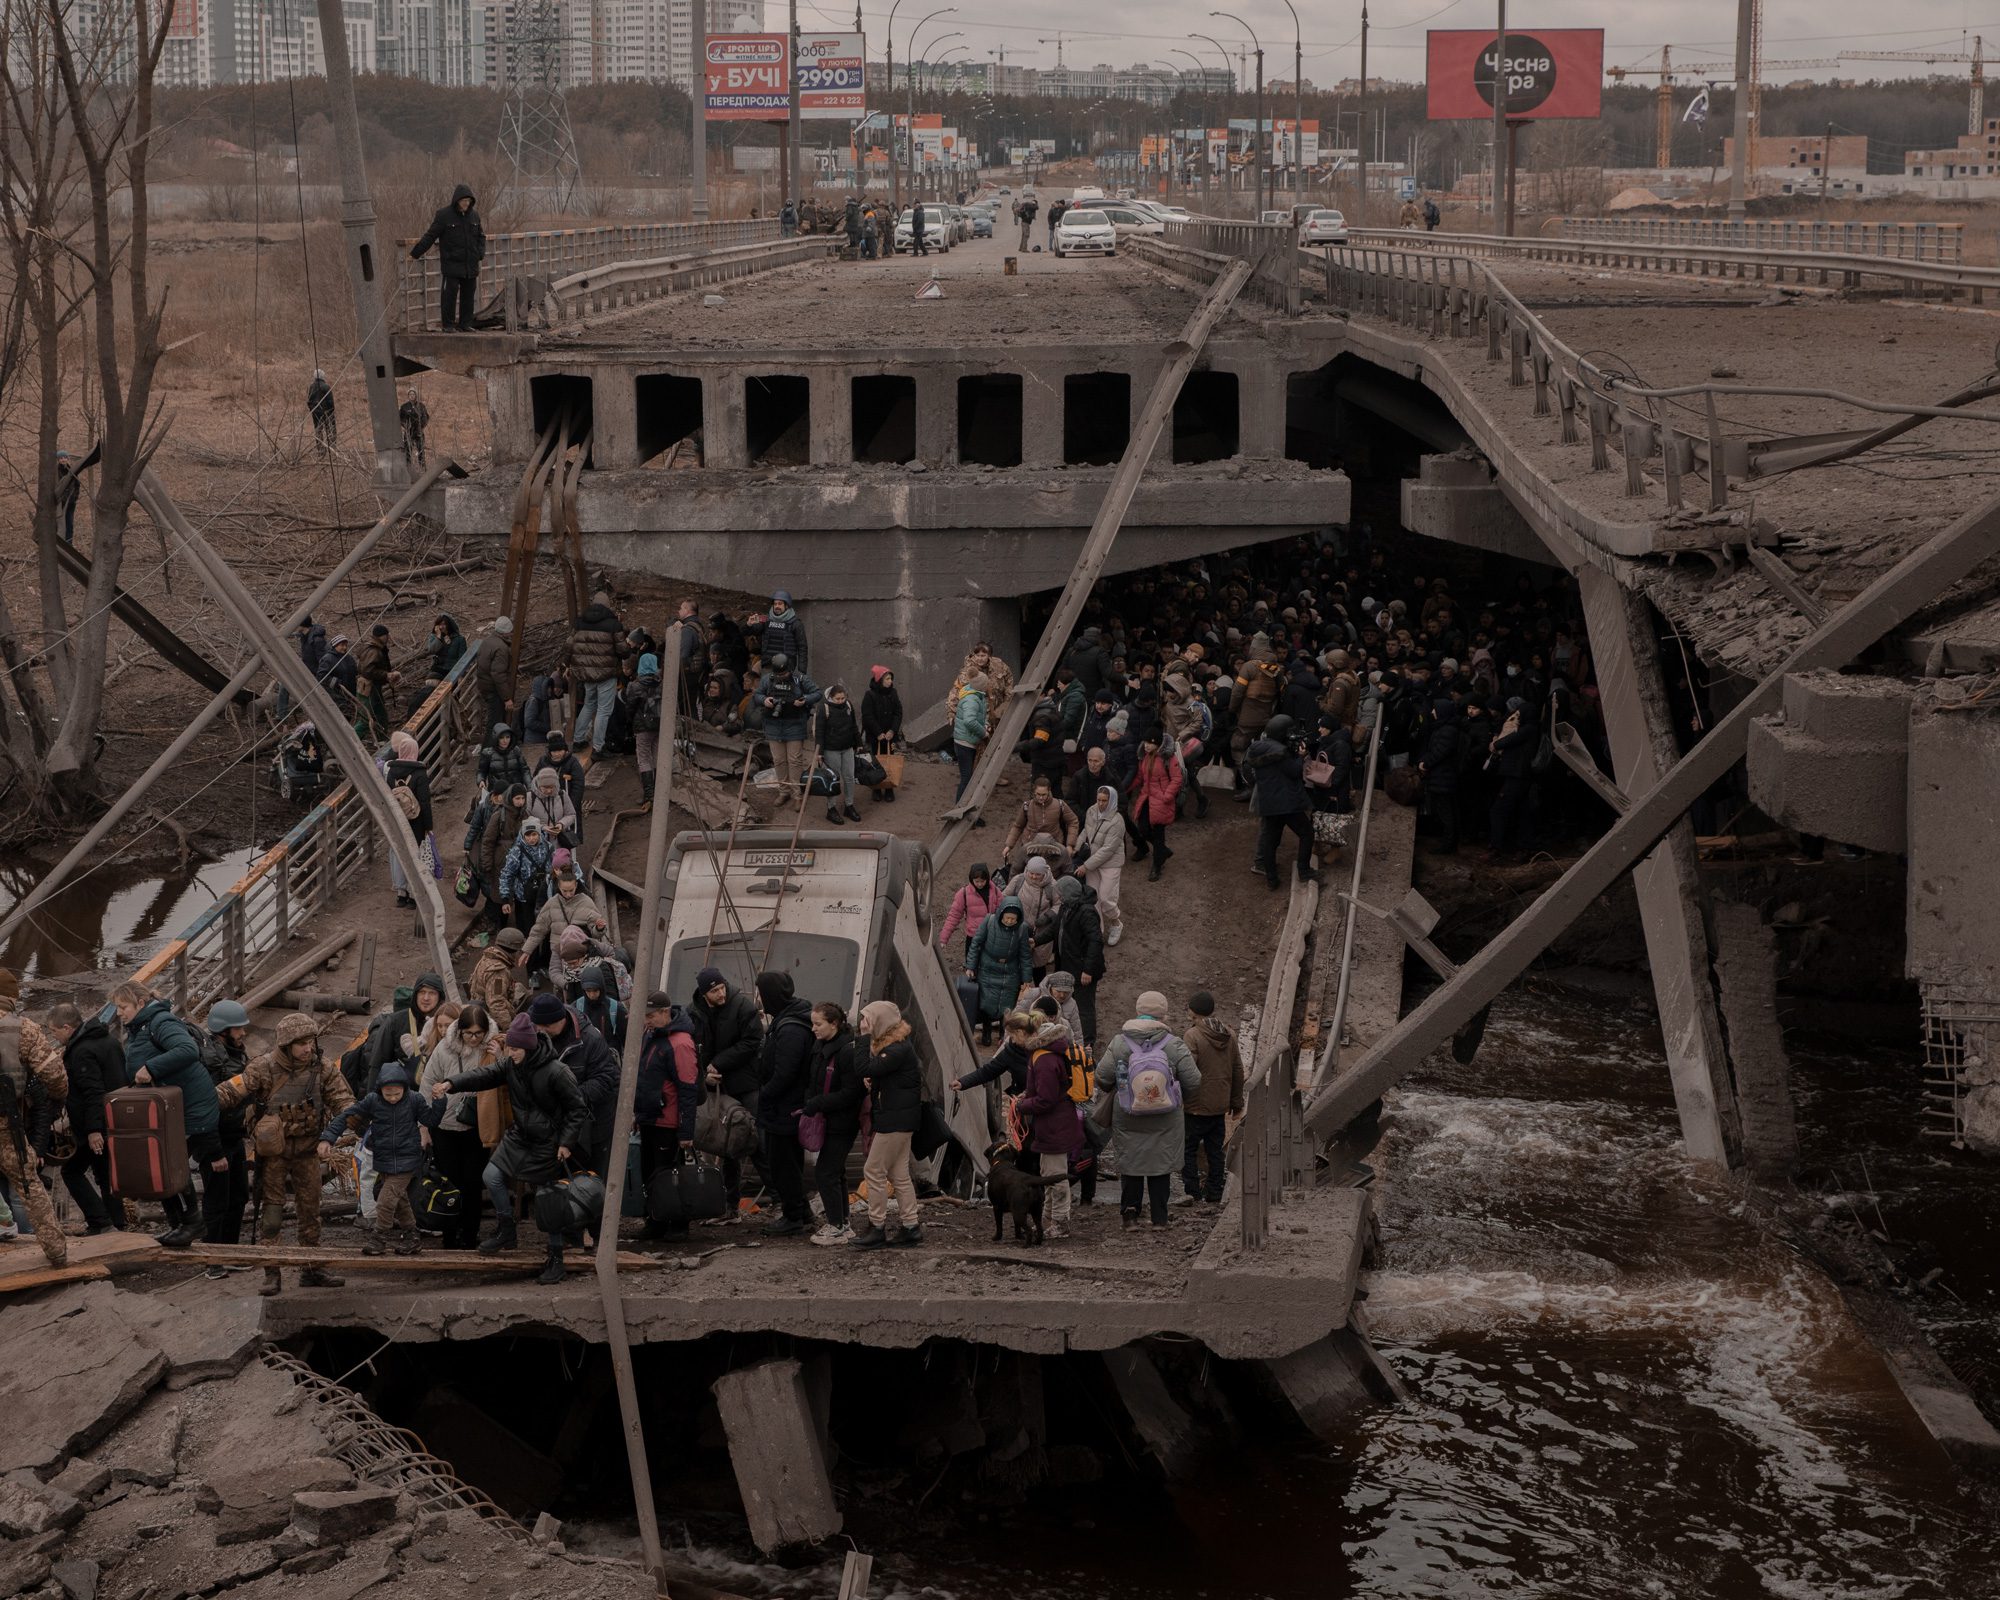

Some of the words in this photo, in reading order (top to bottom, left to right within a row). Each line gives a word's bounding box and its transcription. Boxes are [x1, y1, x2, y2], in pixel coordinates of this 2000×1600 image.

[797, 46, 826, 58] 000
[1484, 52, 1550, 73] Чесна
[708, 75, 722, 92] у
[727, 67, 781, 88] БУЧІ
[797, 68, 849, 87] 2990
[1504, 74, 1536, 95] ра
[708, 96, 790, 107] ПЕРЕДПРОДАЖ
[823, 96, 838, 105] 222
[840, 96, 846, 104] 4
[847, 96, 862, 104] 222
[768, 621, 786, 629] PRESS
[747, 854, 764, 864] MT
[765, 853, 788, 864] 0332
